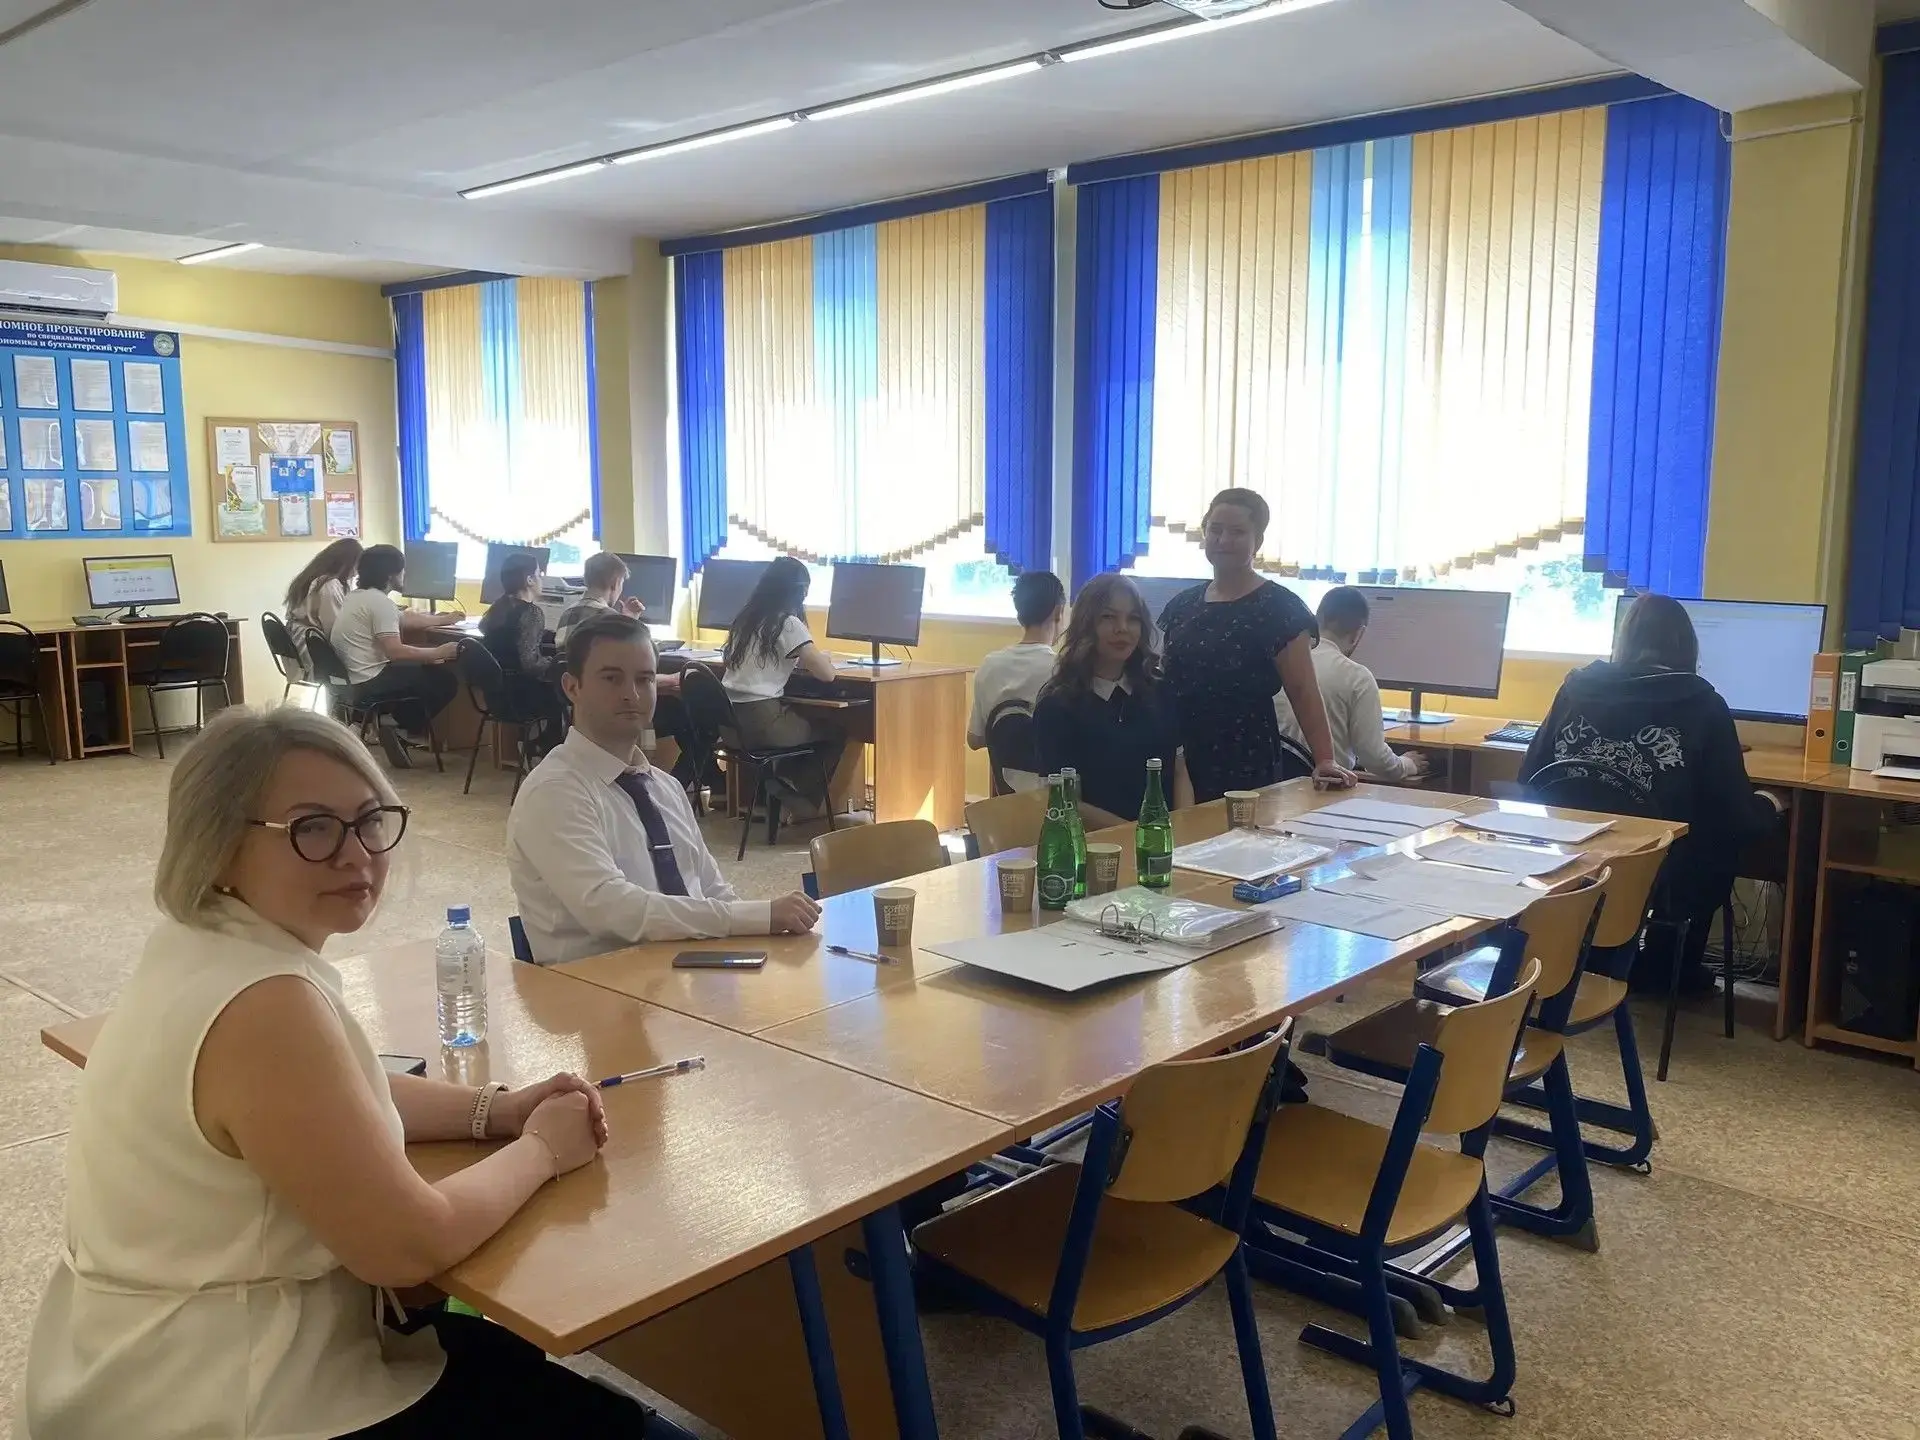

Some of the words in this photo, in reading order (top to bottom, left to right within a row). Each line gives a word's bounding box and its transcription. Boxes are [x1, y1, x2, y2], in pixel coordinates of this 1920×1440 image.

[0, 320, 44, 331] ОМНОЕ
[46, 323, 146, 340] ПРОЕКТИРОВАНИЕ
[38, 333, 96, 343] специальности
[47, 340, 112, 352] бухгалтерский
